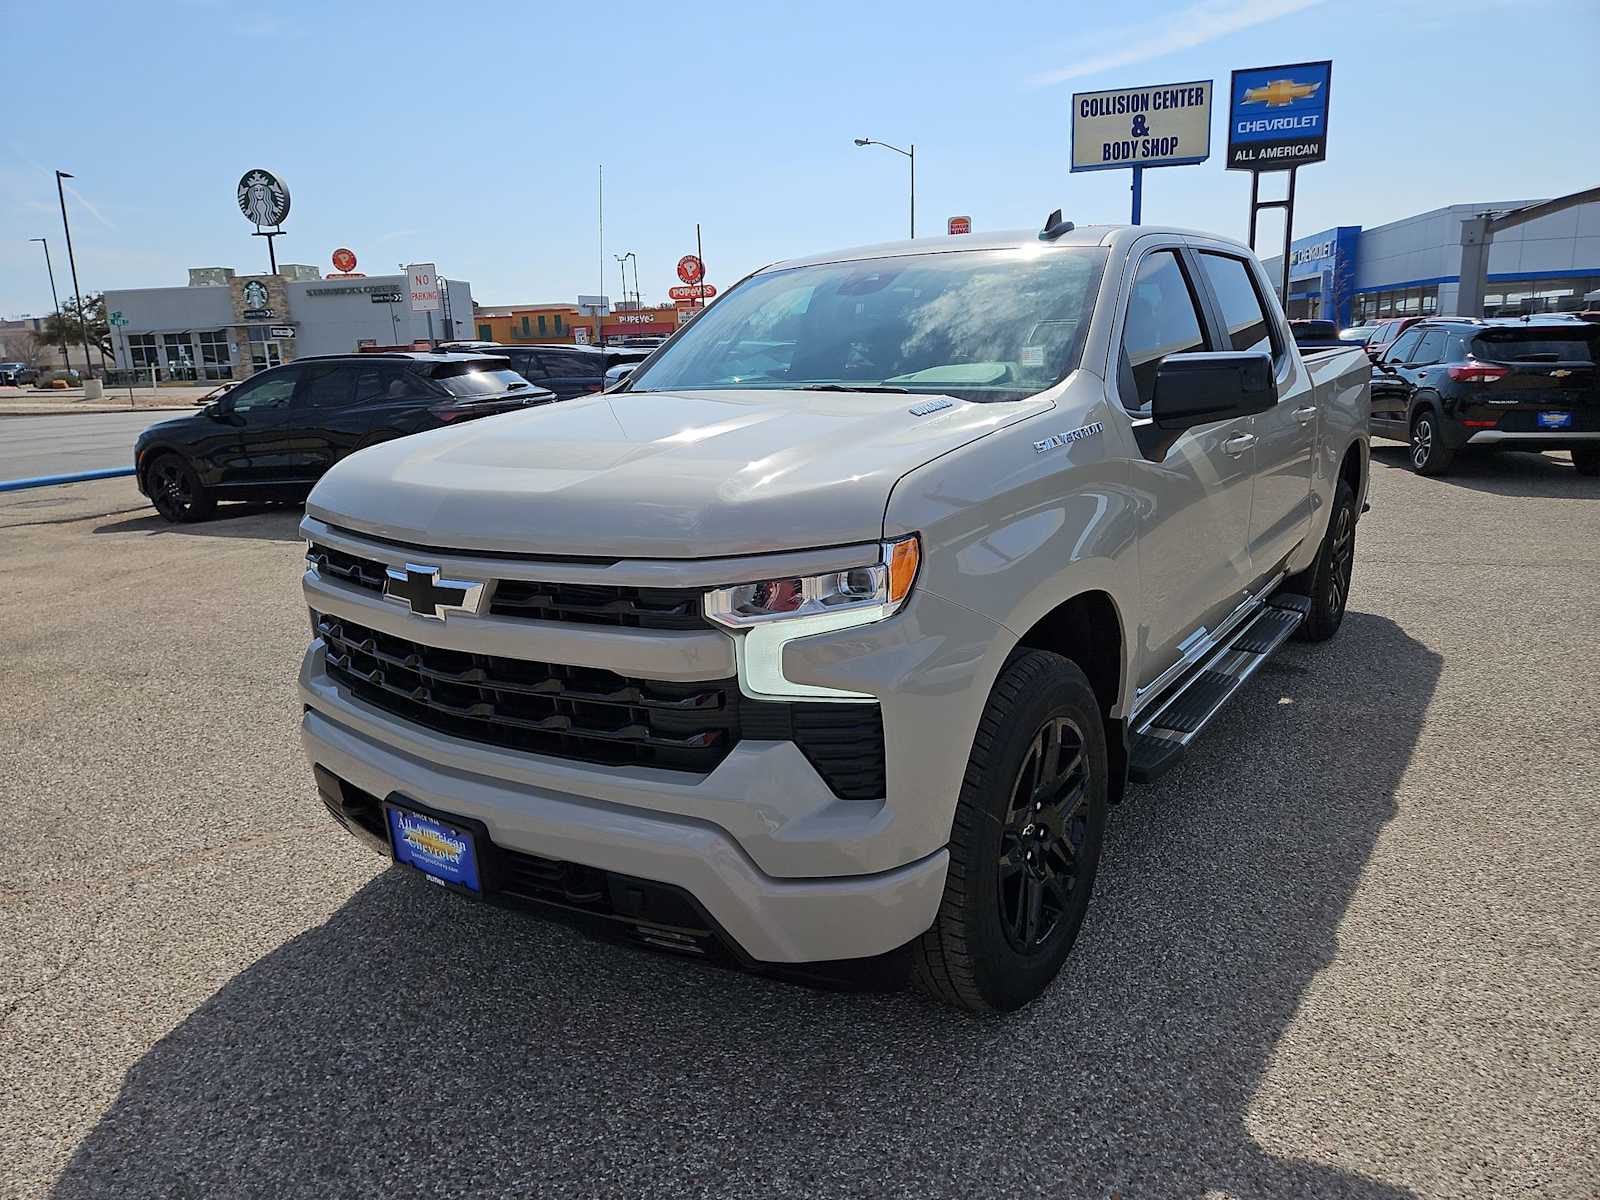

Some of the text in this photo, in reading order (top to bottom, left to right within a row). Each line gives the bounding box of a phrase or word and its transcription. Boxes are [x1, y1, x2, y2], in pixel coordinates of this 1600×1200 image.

[1080, 87, 1204, 118] COLLISION CENTER
[1131, 114, 1150, 138] &
[1237, 115, 1319, 134] CHEVROLET
[1102, 136, 1179, 161] BODY SHOP
[1235, 144, 1319, 161] ALL AMERICAN
[1298, 241, 1336, 264] CHEVROLET
[415, 275, 429, 285] NO
[672, 285, 713, 298] POPEYES
[410, 291, 438, 301] PARKING
[619, 314, 654, 323] POPEYES
[1033, 421, 1104, 454] SILVERADO
[398, 817, 466, 851] All American
[407, 837, 461, 865] Chevrolet
